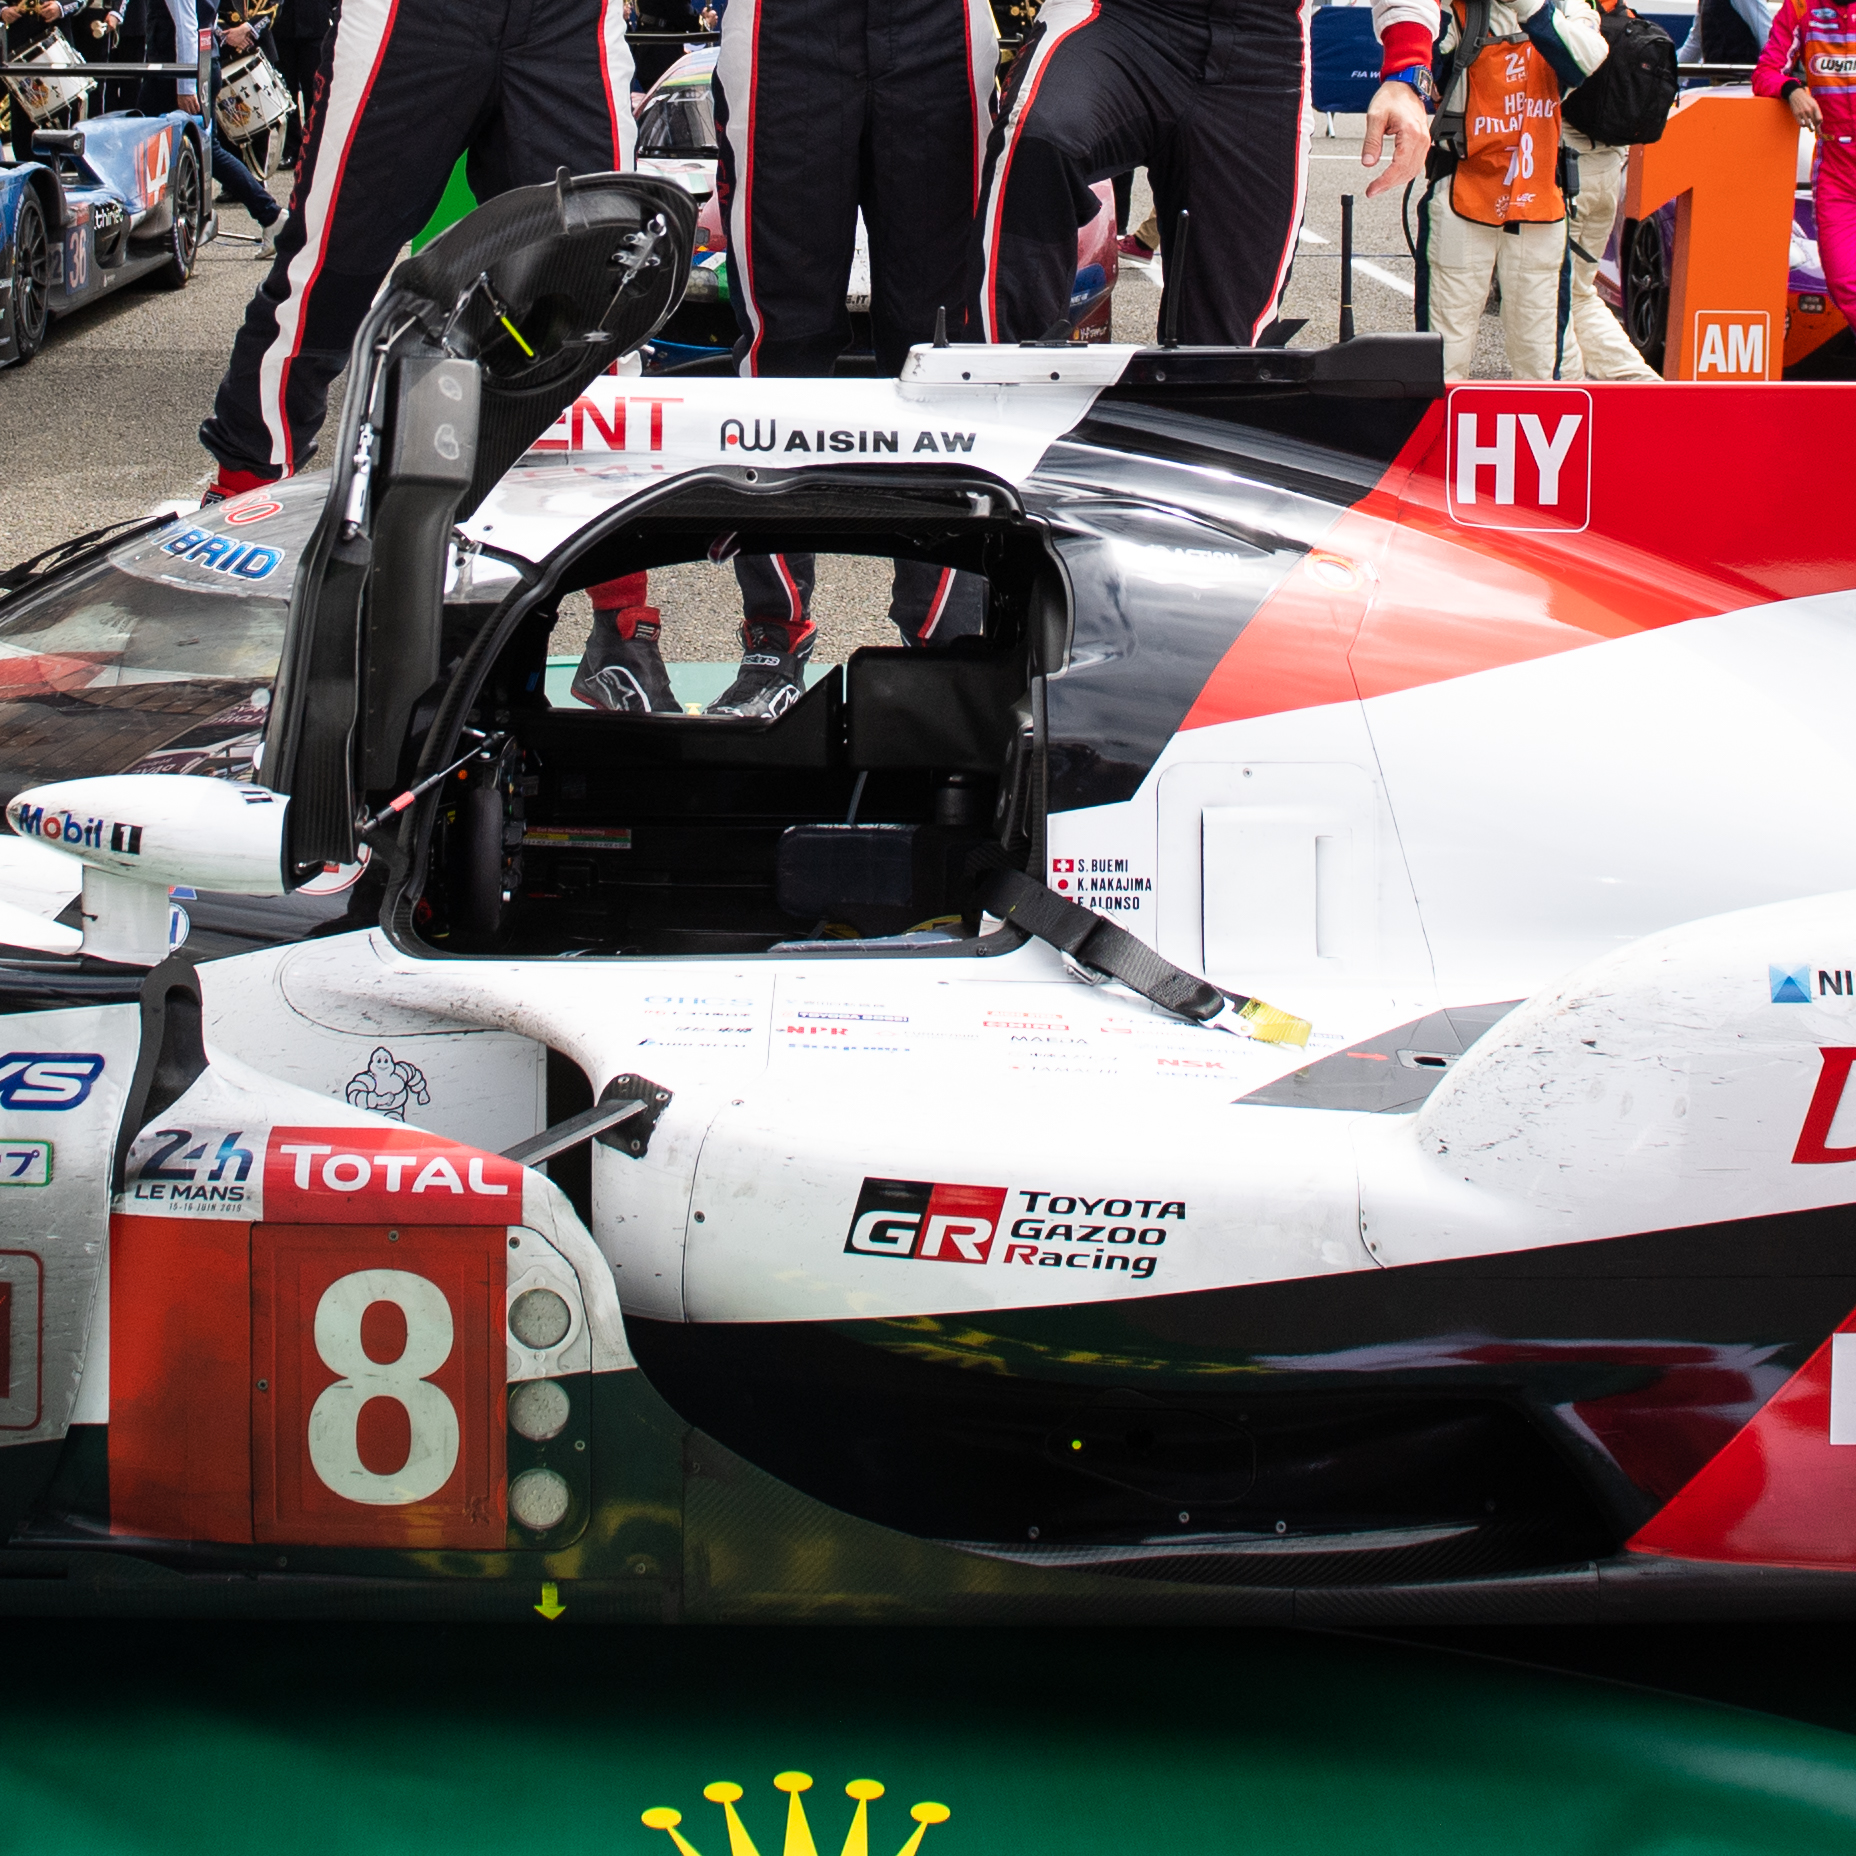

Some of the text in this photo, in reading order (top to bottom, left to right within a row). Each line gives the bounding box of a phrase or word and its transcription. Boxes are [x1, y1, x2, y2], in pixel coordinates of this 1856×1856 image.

[69, 227, 87, 289] 36
[1698, 324, 1767, 376] AM
[784, 430, 976, 453] AISIN AW
[1455, 411, 1584, 506] HY
[18, 802, 105, 851] Mobil
[1090, 896, 1140, 910] ALONSO
[1157, 1058, 1228, 1070] NSK
[138, 1129, 254, 1183] 24h
[280, 1144, 509, 1195] TOTAL
[135, 1184, 245, 1202] LE MANS
[169, 1202, 242, 1213] 15-16 JUIN 2019
[1017, 1189, 1187, 1221] TOYOTA
[849, 1210, 995, 1263] GR
[1010, 1217, 1167, 1247] GAZOO
[1003, 1242, 1158, 1280] Racing
[306, 1267, 461, 1506] 8
